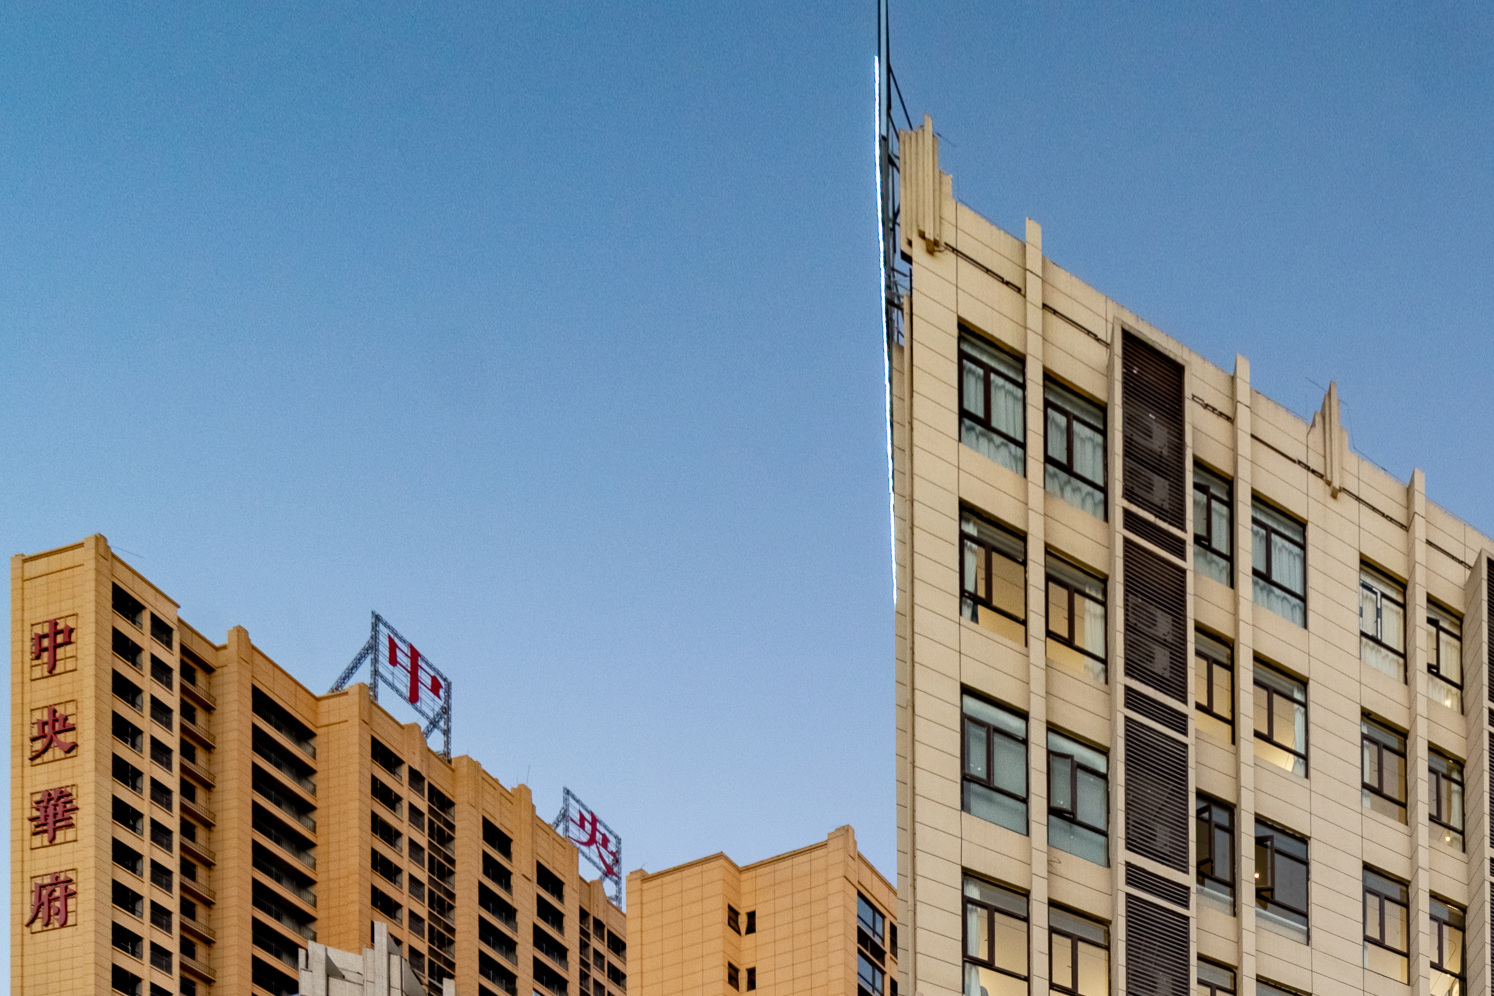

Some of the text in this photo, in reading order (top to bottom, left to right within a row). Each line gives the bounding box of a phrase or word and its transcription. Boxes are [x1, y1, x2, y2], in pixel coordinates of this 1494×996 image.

[388, 633, 443, 704] 中
[25, 618, 79, 928] 中央華府
[569, 810, 620, 880] 央
